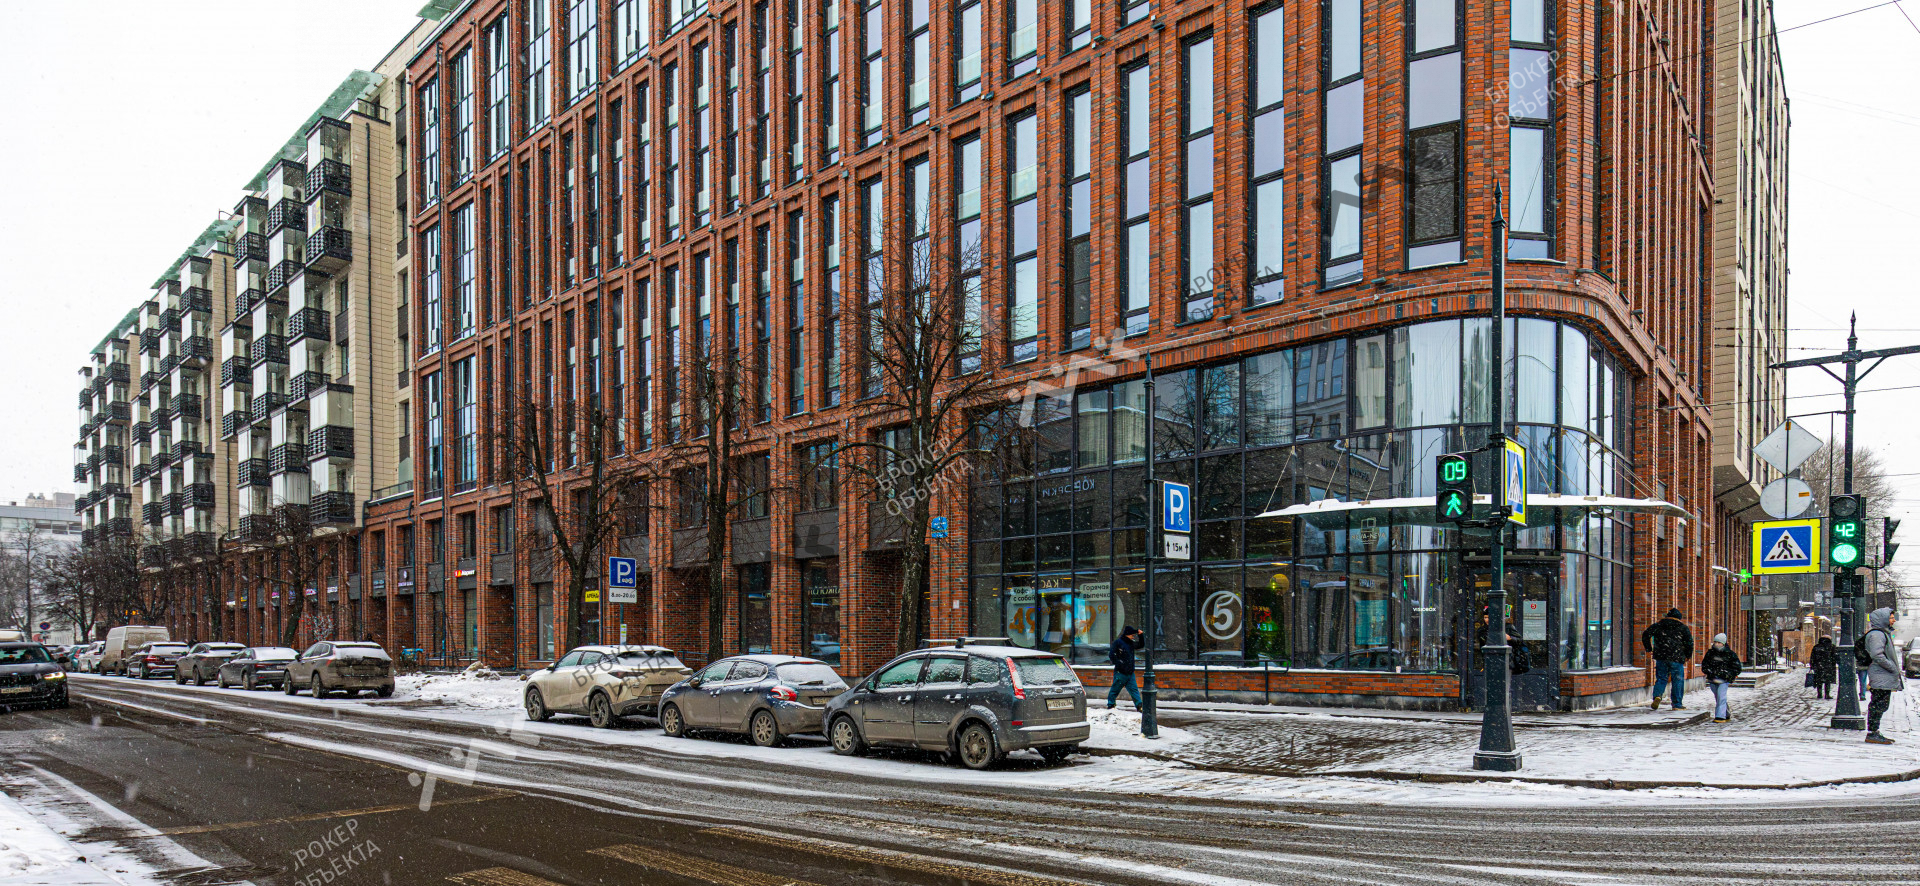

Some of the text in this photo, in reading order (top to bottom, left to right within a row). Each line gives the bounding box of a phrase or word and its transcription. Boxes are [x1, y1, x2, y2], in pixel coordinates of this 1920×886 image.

[1445, 461, 1466, 481] 09
[1170, 489, 1184, 525] P
[1836, 524, 1855, 536] 42
[617, 561, 631, 583] P
[1083, 584, 1109, 592] Горячая
[1097, 604, 1108, 614] 99
[1009, 608, 1035, 633] 49
